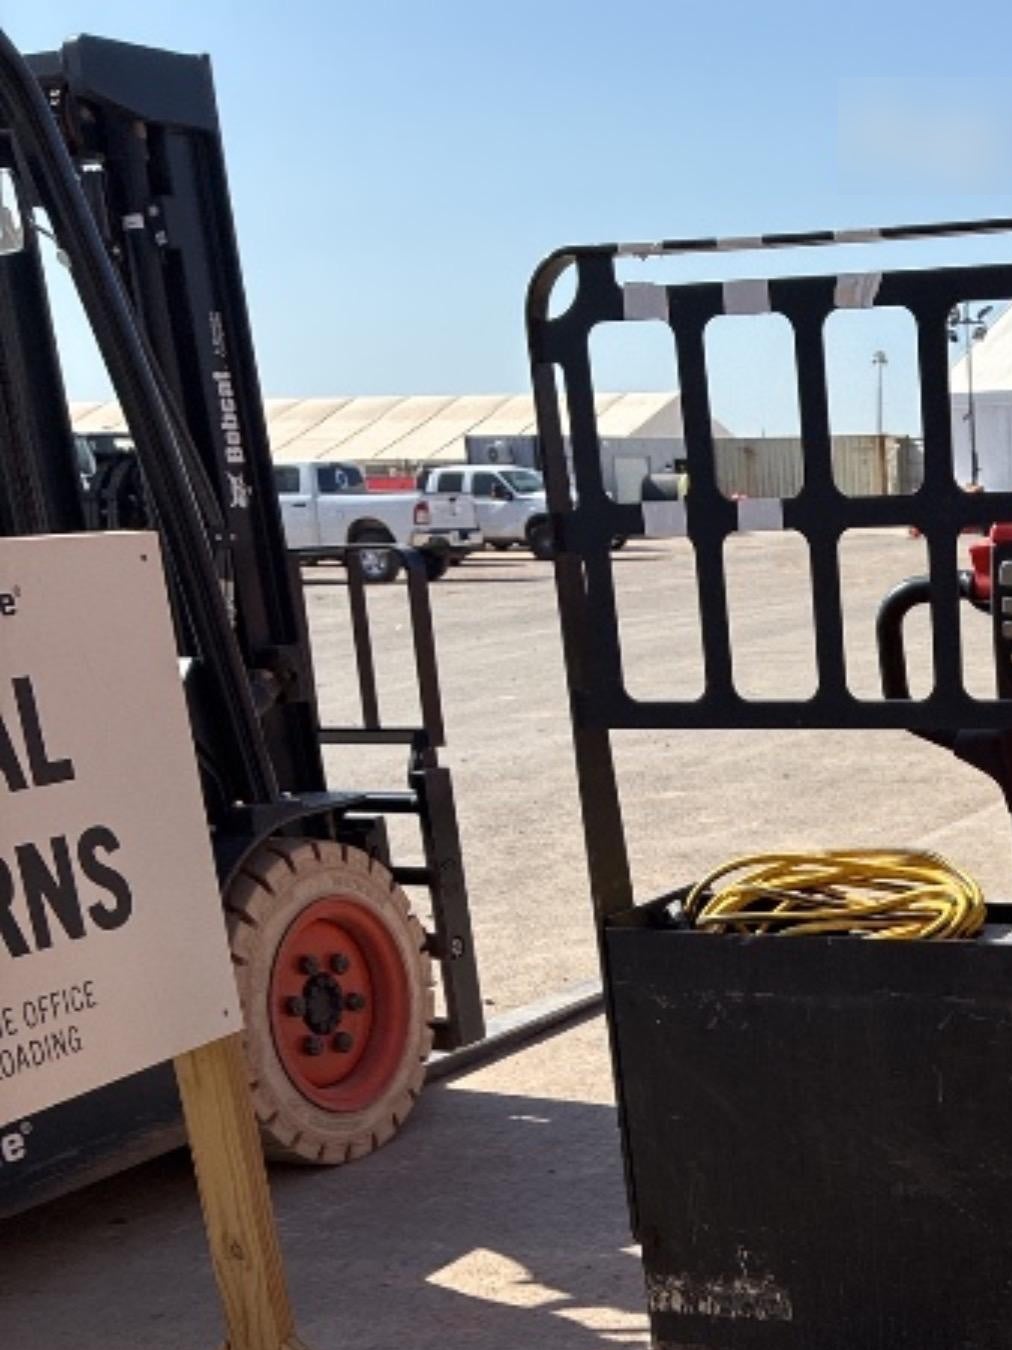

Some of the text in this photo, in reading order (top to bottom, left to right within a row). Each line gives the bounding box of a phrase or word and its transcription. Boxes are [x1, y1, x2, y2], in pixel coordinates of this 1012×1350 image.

[213, 371, 245, 464] Bobcat
[22, 980, 98, 1029] OFFICE
[0, 1025, 84, 1081] OADING
